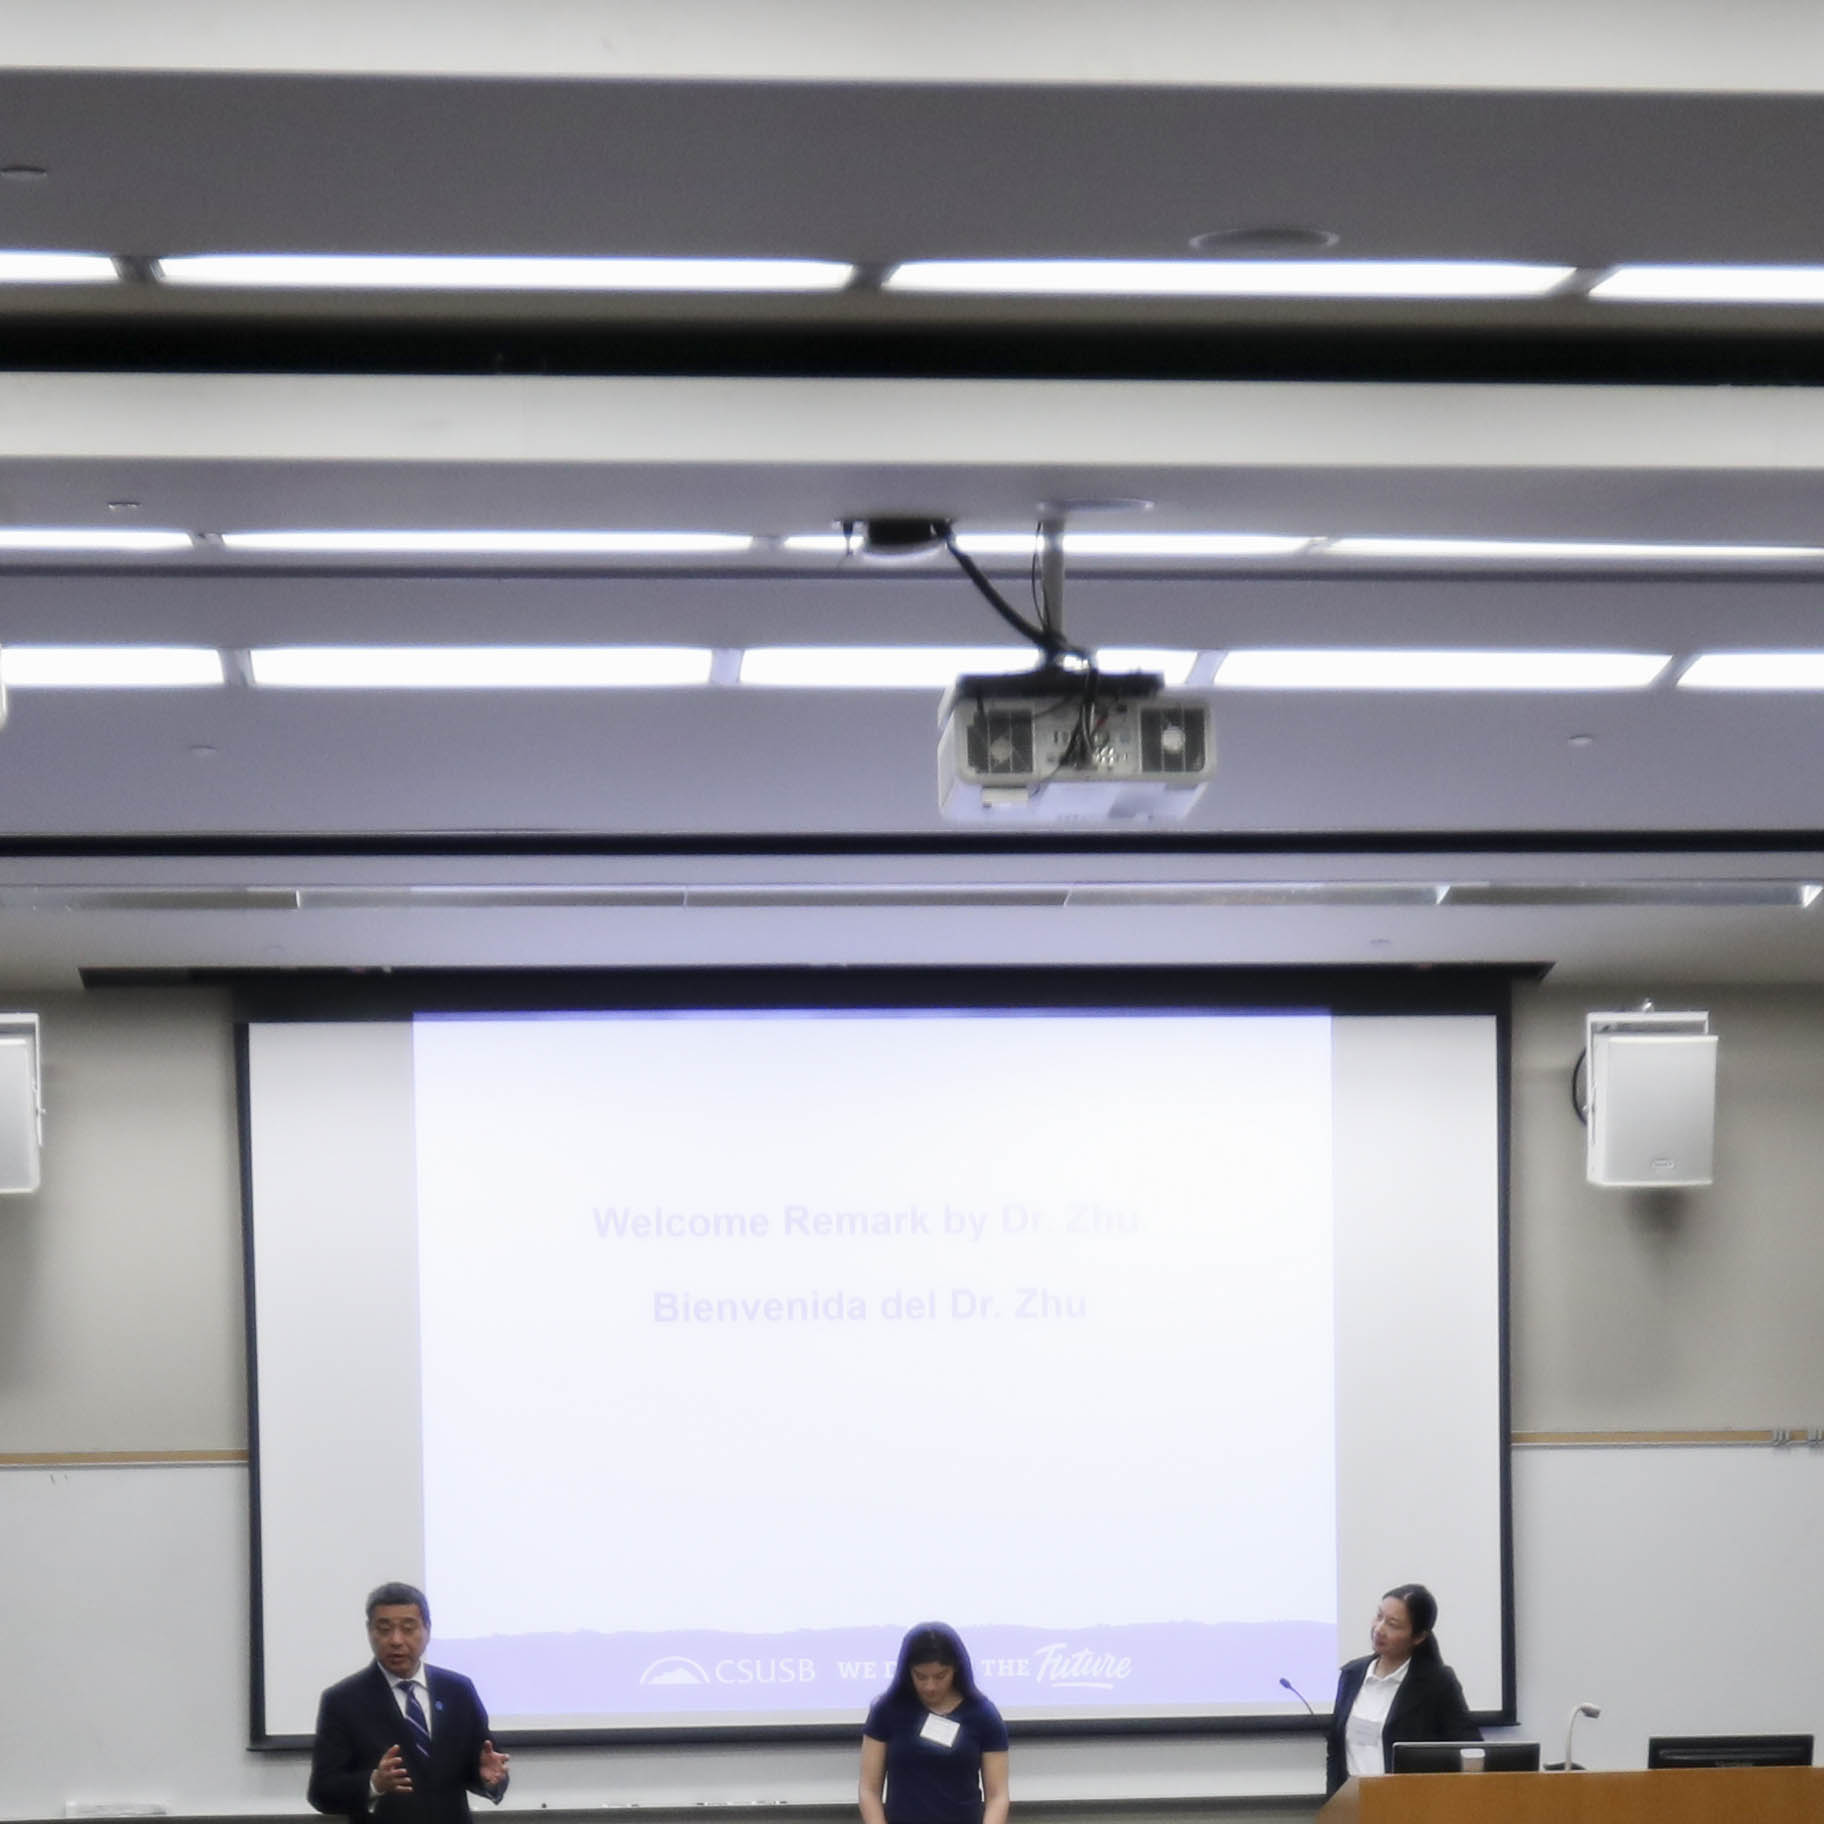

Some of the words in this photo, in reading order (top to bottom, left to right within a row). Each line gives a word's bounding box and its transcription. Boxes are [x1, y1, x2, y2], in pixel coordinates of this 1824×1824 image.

[593, 1206, 770, 1240] Welcome
[783, 1205, 930, 1238] Remark
[943, 1204, 988, 1244] by
[1002, 1204, 1055, 1234] Dr.
[1066, 1203, 1139, 1234] Zhu
[653, 1289, 868, 1325] Bienvenida
[880, 1289, 938, 1322] del
[951, 1288, 1002, 1321] Dr.
[1015, 1287, 1087, 1320] Zhu
[714, 1658, 817, 1686] CSUSB
[837, 1660, 879, 1681] WE
[981, 1658, 1032, 1678] THE
[1033, 1642, 1134, 1686] Future
